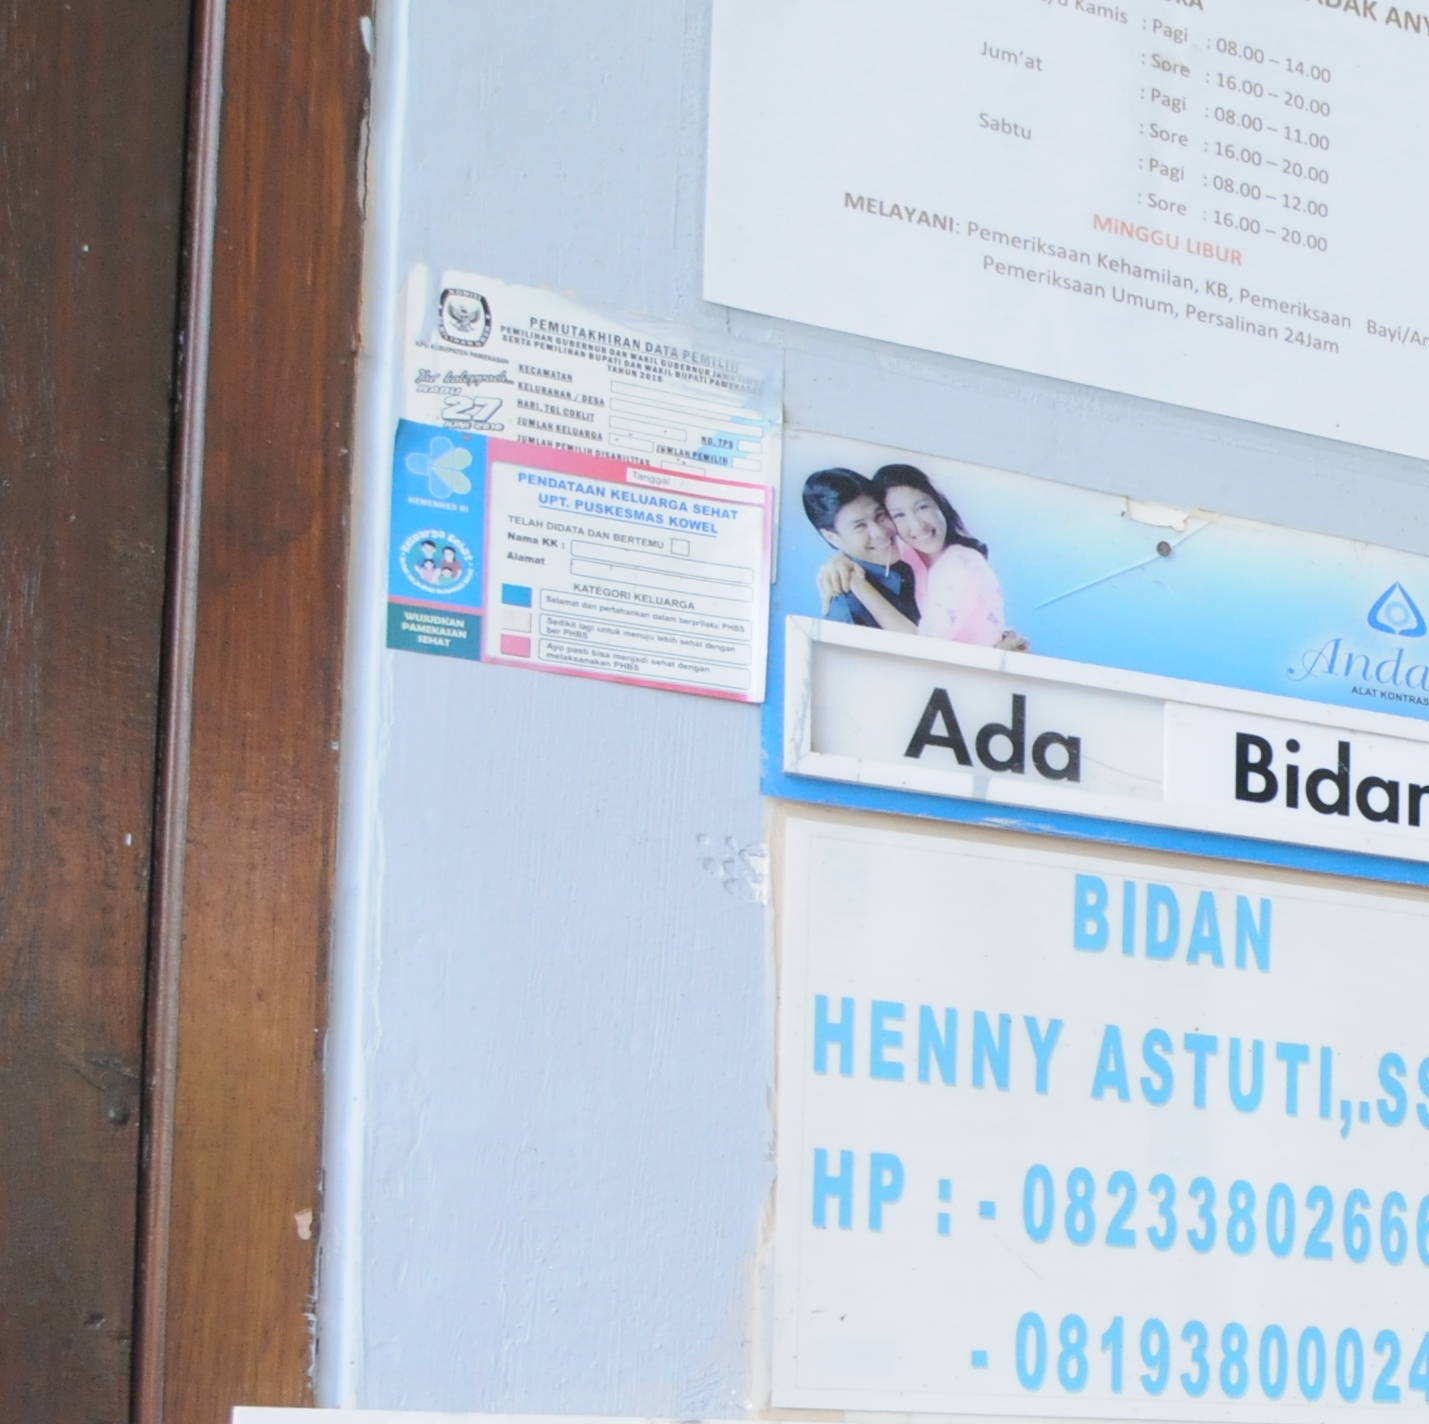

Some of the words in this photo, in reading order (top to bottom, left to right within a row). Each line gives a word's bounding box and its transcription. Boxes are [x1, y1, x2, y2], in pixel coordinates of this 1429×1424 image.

[1075, 0, 1128, 24] Kamis
[1152, 18, 1188, 44] Pagi
[1216, 38, 1265, 63] 08.00
[1285, 58, 1331, 83] 14.00
[980, 41, 1043, 72] Jum'at
[1151, 88, 1186, 113] Pagi
[1214, 107, 1263, 132] 08.00
[1284, 126, 1330, 151] 11.00
[1151, 53, 1191, 78] Sore
[1216, 72, 1264, 98] 16.00
[1284, 92, 1331, 117] 20.00
[979, 112, 1032, 141] Sabtu
[1149, 157, 1185, 183] Pagi
[1213, 175, 1261, 200] 08.00
[1282, 194, 1328, 218] 12.00
[1149, 123, 1189, 148] Sore
[1215, 142, 1262, 167] 16.00
[1283, 160, 1329, 185] 20.00
[1147, 192, 1187, 217] Sore
[1213, 210, 1261, 235] 16.00
[1281, 228, 1327, 252] 20.00
[844, 192, 960, 234] MELAYANI:
[967, 220, 1090, 265] Pemeriksaan
[1098, 252, 1199, 294] Kehamilan,
[1205, 280, 1233, 303] KB,
[1240, 288, 1351, 329] Pemeriksaan
[1186, 238, 1243, 266] LIBUR
[983, 255, 1105, 298] Pemeriksaan
[1112, 287, 1179, 318] Umum,
[1185, 303, 1278, 340] Persalinan
[1284, 327, 1340, 354] 24Jam
[530, 317, 641, 350] PEMUTAKHIRAN
[645, 342, 678, 358] DATA
[630, 350, 659, 364] WAKIL
[518, 364, 573, 383] KECAMATAN
[589, 352, 621, 366] BUPATI
[644, 363, 673, 377] WAKIL
[607, 364, 638, 379] TAHUN
[441, 395, 503, 424] 27
[518, 382, 571, 401] KELURAHAN
[582, 393, 605, 407] DESA
[563, 407, 595, 422] COKLIT
[517, 417, 552, 432] JUMLAH
[555, 422, 603, 440] KELUARGA
[518, 471, 606, 497] PENDATAAN
[610, 488, 688, 512] KELUARGA
[692, 504, 739, 521] SEHAT
[538, 493, 570, 508] UPT.
[575, 500, 664, 526] PUSKESMAS
[668, 517, 718, 534] KOWEL
[507, 531, 538, 546] Nama
[541, 536, 558, 549] KK
[508, 515, 543, 531] TELAH
[546, 521, 583, 537] DIDATA
[586, 527, 610, 540] DAN
[612, 531, 664, 549] BERTEMU
[506, 551, 546, 567] Alamat
[573, 582, 631, 602] KATEGORI
[633, 590, 695, 611] KELUARGA
[1351, 686, 1377, 699] ALAT
[905, 688, 1082, 783] Ada
[1073, 872, 1273, 972] BIDAN
[813, 994, 1064, 1096] HENNY
[811, 1148, 905, 1231] HP
